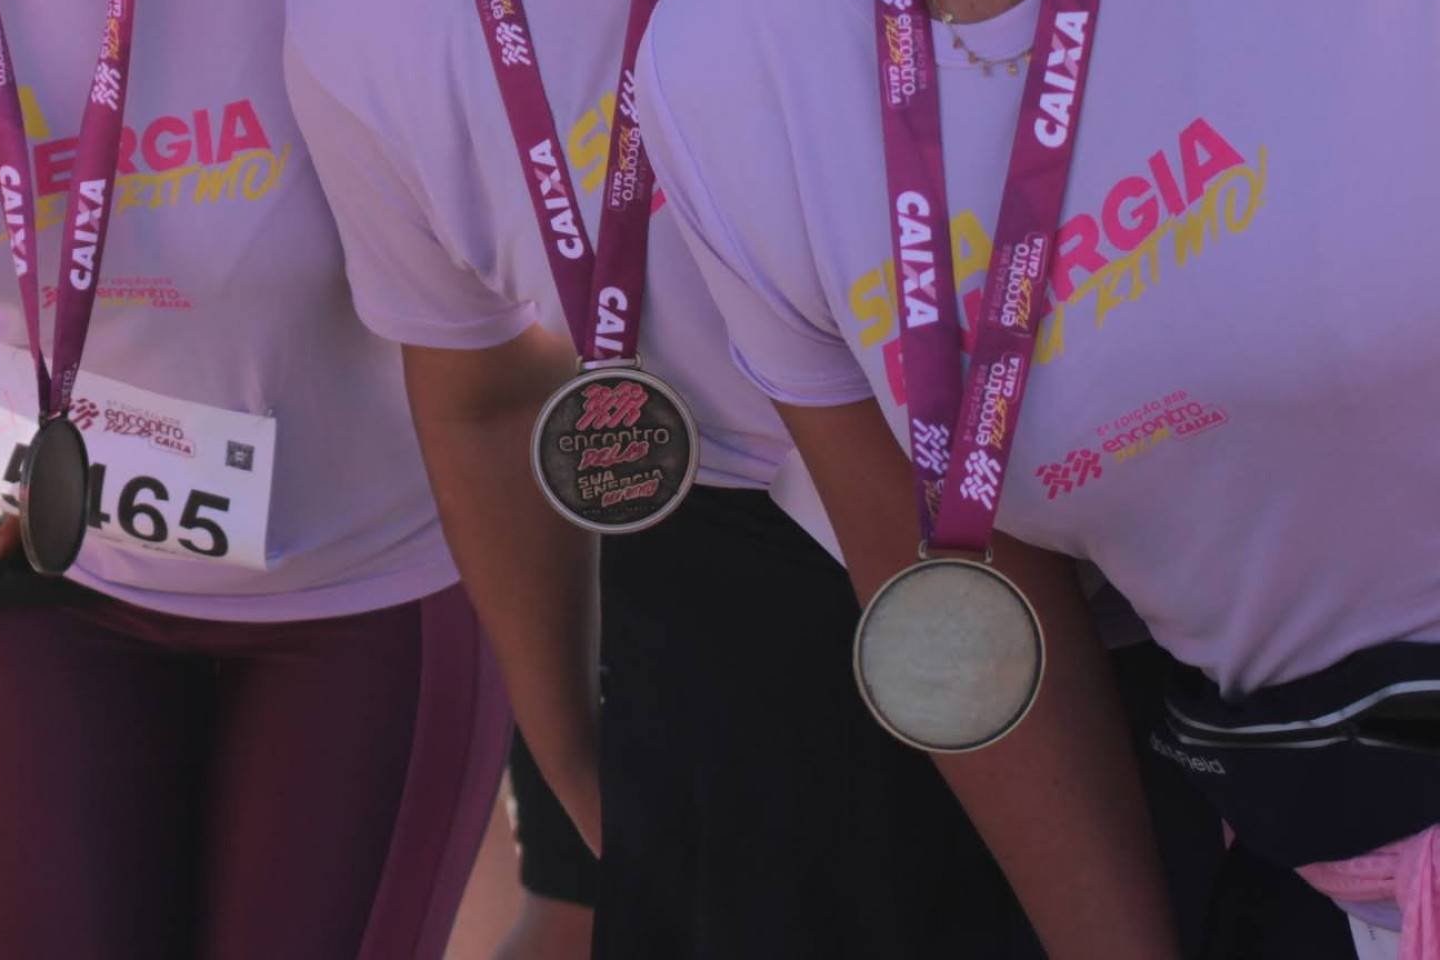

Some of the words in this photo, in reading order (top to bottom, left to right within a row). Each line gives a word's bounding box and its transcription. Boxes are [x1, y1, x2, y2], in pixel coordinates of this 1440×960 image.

[897, 13, 917, 96] encontro
[1034, 11, 1089, 148] CAIXA
[0, 165, 28, 277] CAIXA
[529, 138, 584, 260] CAIXA
[70, 178, 106, 291] CAIXA
[896, 190, 939, 328] CAIXA
[1027, 238, 1044, 278] CAIXA
[1001, 243, 1030, 327] encontro
[975, 362, 1006, 446] encontro
[1002, 357, 1021, 398] CAIXA
[104, 408, 184, 440] encontro
[155, 436, 192, 454] CAIXA
[559, 426, 670, 452] encontro
[1103, 402, 1203, 453] encontro
[1176, 411, 1225, 434] CAIXA
[577, 470, 615, 489] SUA
